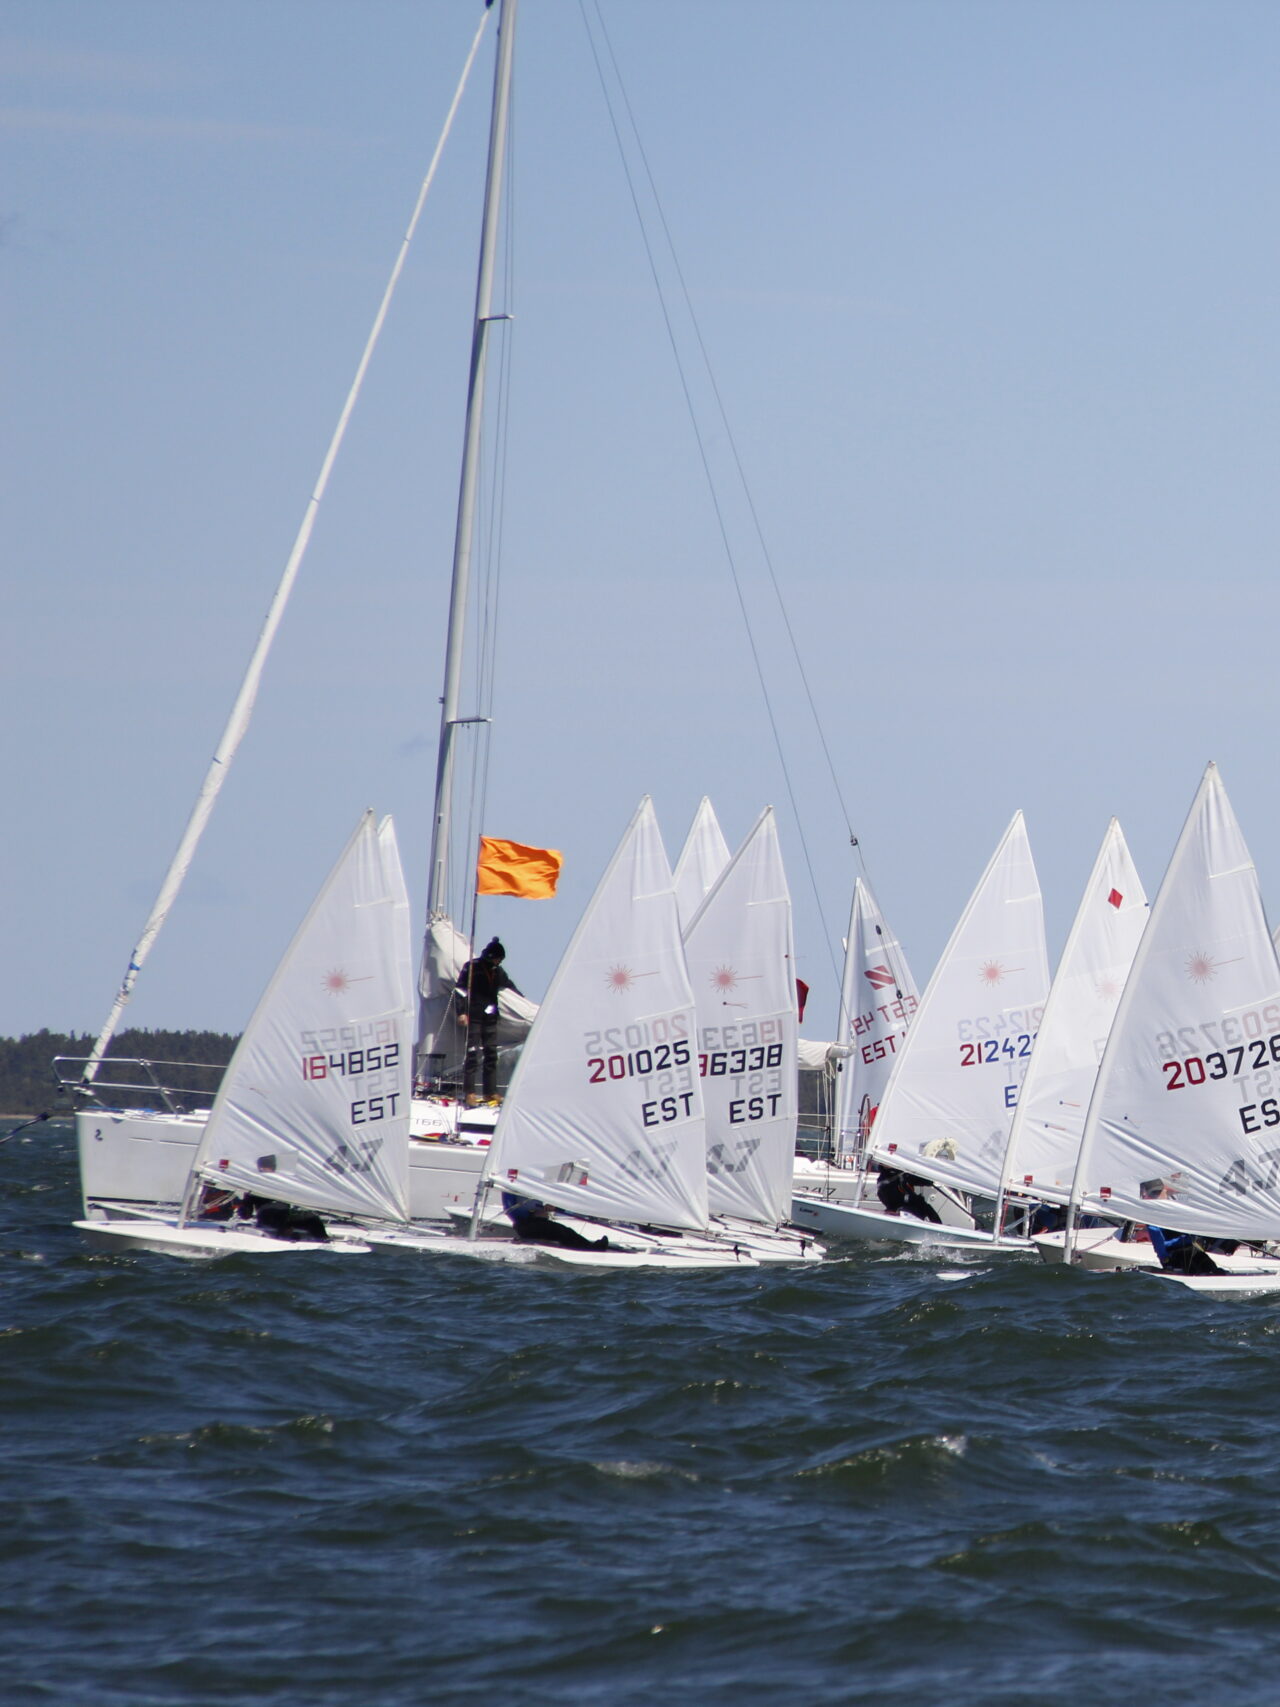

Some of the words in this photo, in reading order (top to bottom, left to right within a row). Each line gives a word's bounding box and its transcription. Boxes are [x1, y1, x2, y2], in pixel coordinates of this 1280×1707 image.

[302, 1043, 399, 1080] 164852
[587, 1040, 690, 1084] 201025
[698, 1044, 783, 1077] 96338
[861, 1035, 895, 1064] EST
[959, 1032, 1037, 1066] 21242
[352, 1093, 400, 1125] EST
[642, 1092, 693, 1127] EST
[729, 1094, 782, 1124] EST
